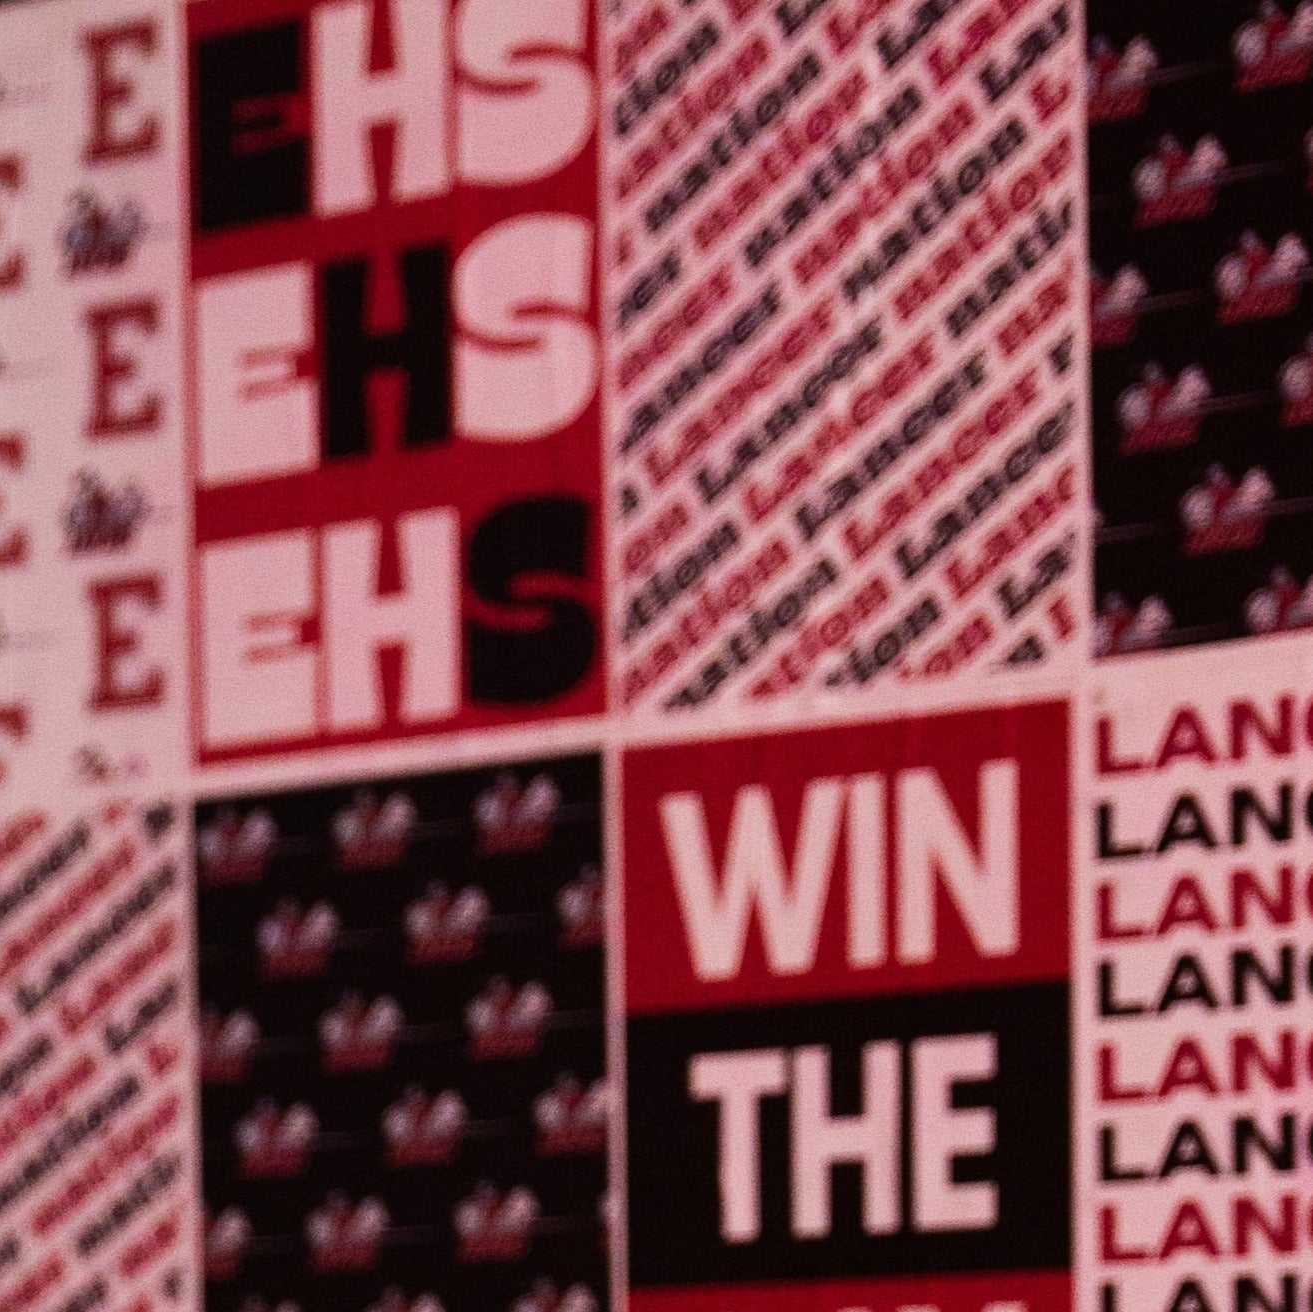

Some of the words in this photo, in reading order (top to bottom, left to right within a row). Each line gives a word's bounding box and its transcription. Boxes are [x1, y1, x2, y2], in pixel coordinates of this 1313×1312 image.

[81, 20, 160, 165] E
[196, 0, 599, 232] EHS
[85, 299, 163, 440] E
[195, 212, 599, 486] EHS
[892, 400, 1075, 583] Lance
[87, 575, 166, 714] E
[199, 495, 597, 749] EHS
[1094, 694, 1313, 776] LAN
[656, 757, 1022, 983] WIN
[1094, 782, 1313, 861] LAN
[1094, 865, 1313, 943] LAN
[1094, 942, 1313, 1019] LAN
[1098, 1029, 1313, 1104] LAN
[686, 1031, 1000, 1245] THE
[1098, 1112, 1313, 1183] LAN
[1098, 1194, 1313, 1265] LAN
